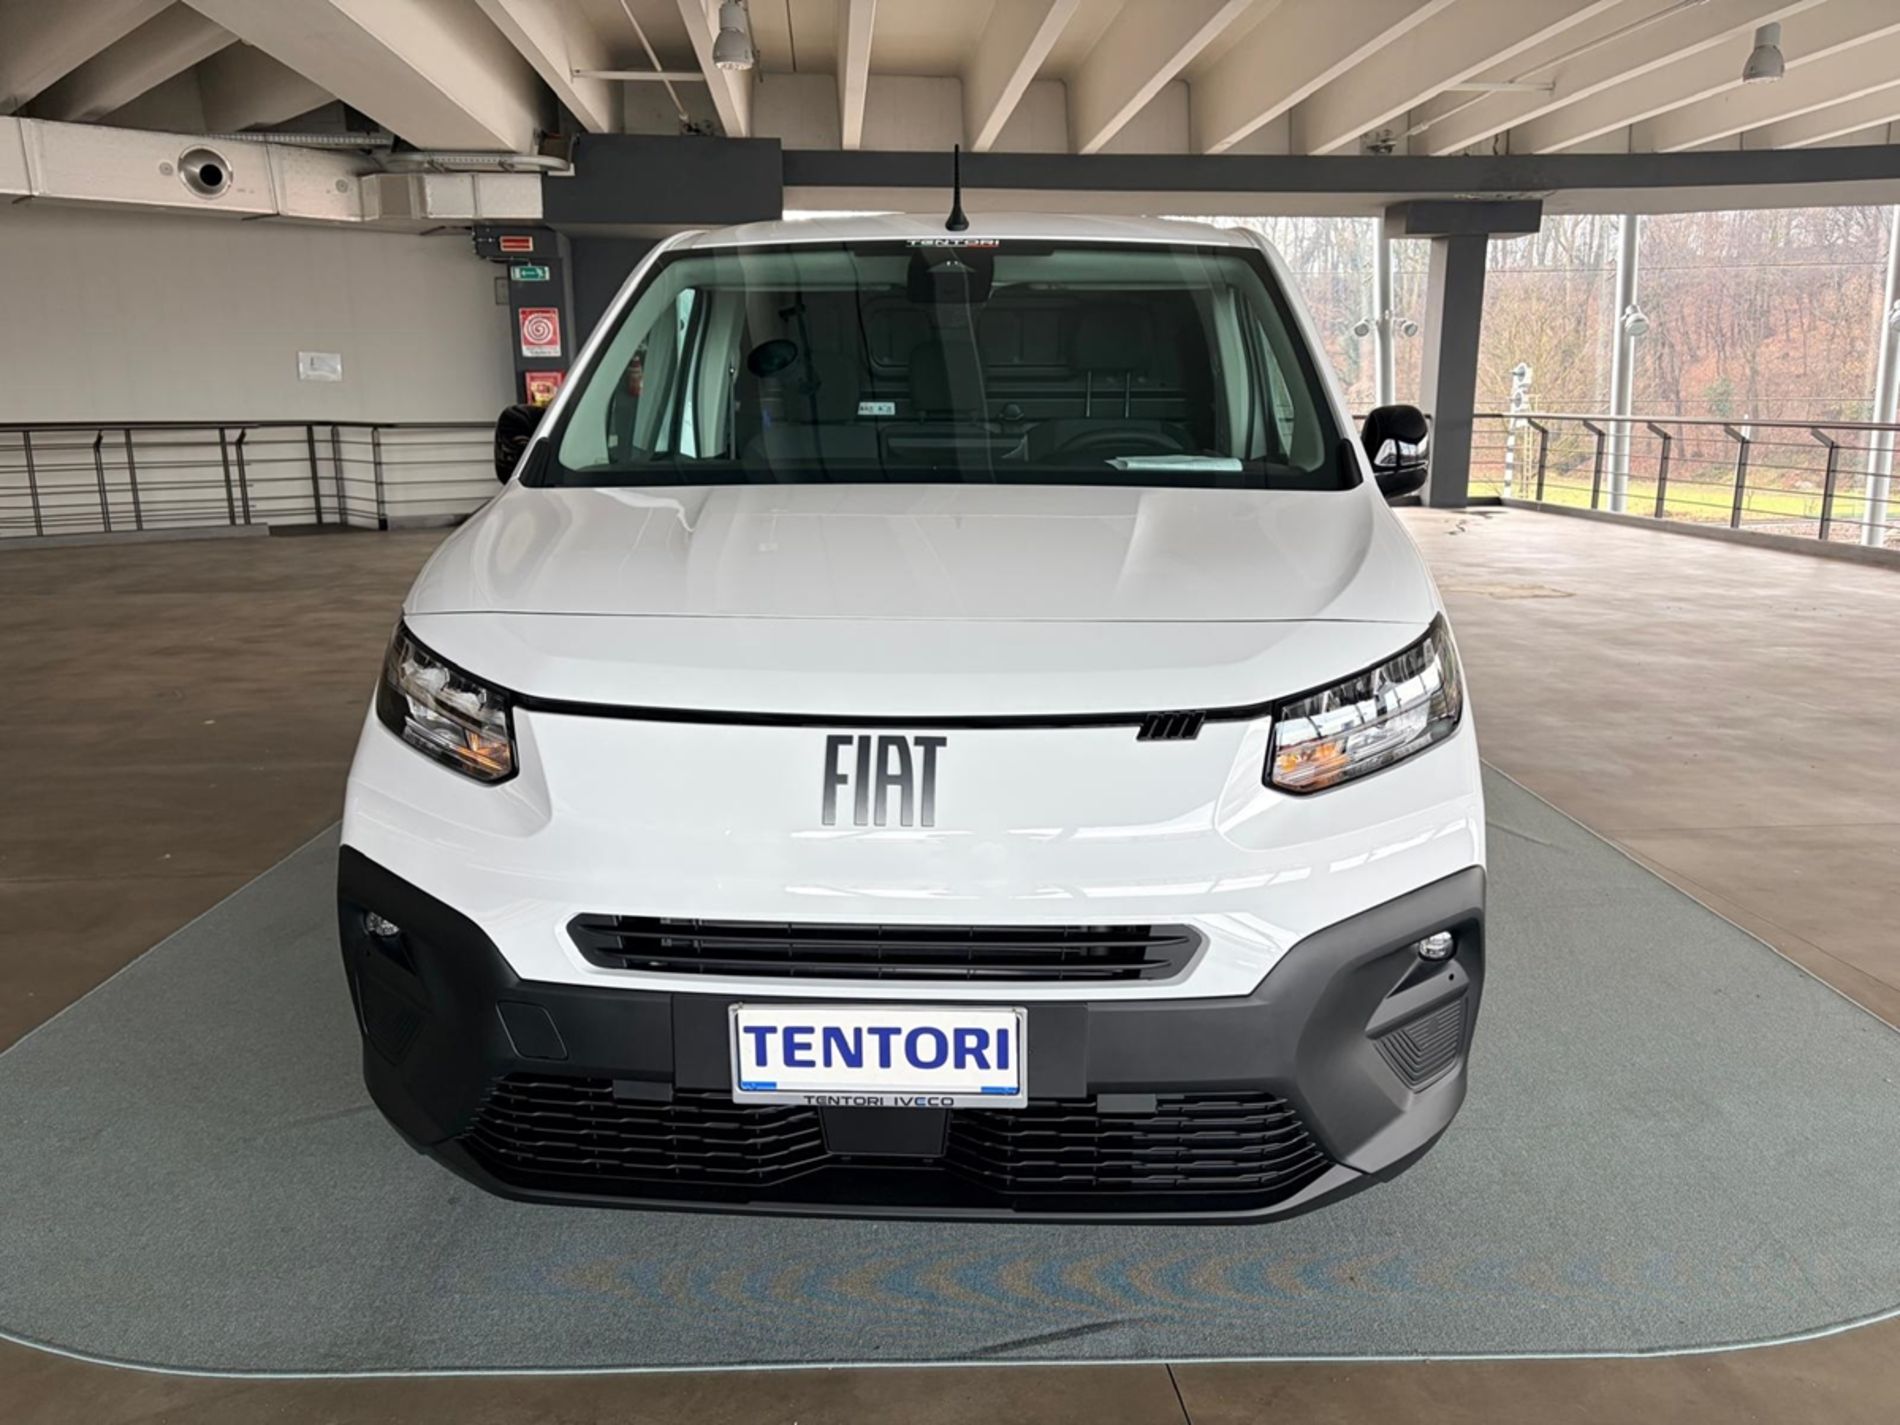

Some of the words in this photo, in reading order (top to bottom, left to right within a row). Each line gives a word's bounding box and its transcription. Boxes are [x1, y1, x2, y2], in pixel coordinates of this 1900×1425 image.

[906, 239, 1000, 248] TENTORI
[822, 735, 947, 827] FIAT
[743, 1026, 1009, 1070] TENTORI
[803, 1095, 884, 1106] TENTORI
[894, 1096, 954, 1107] IVECO
